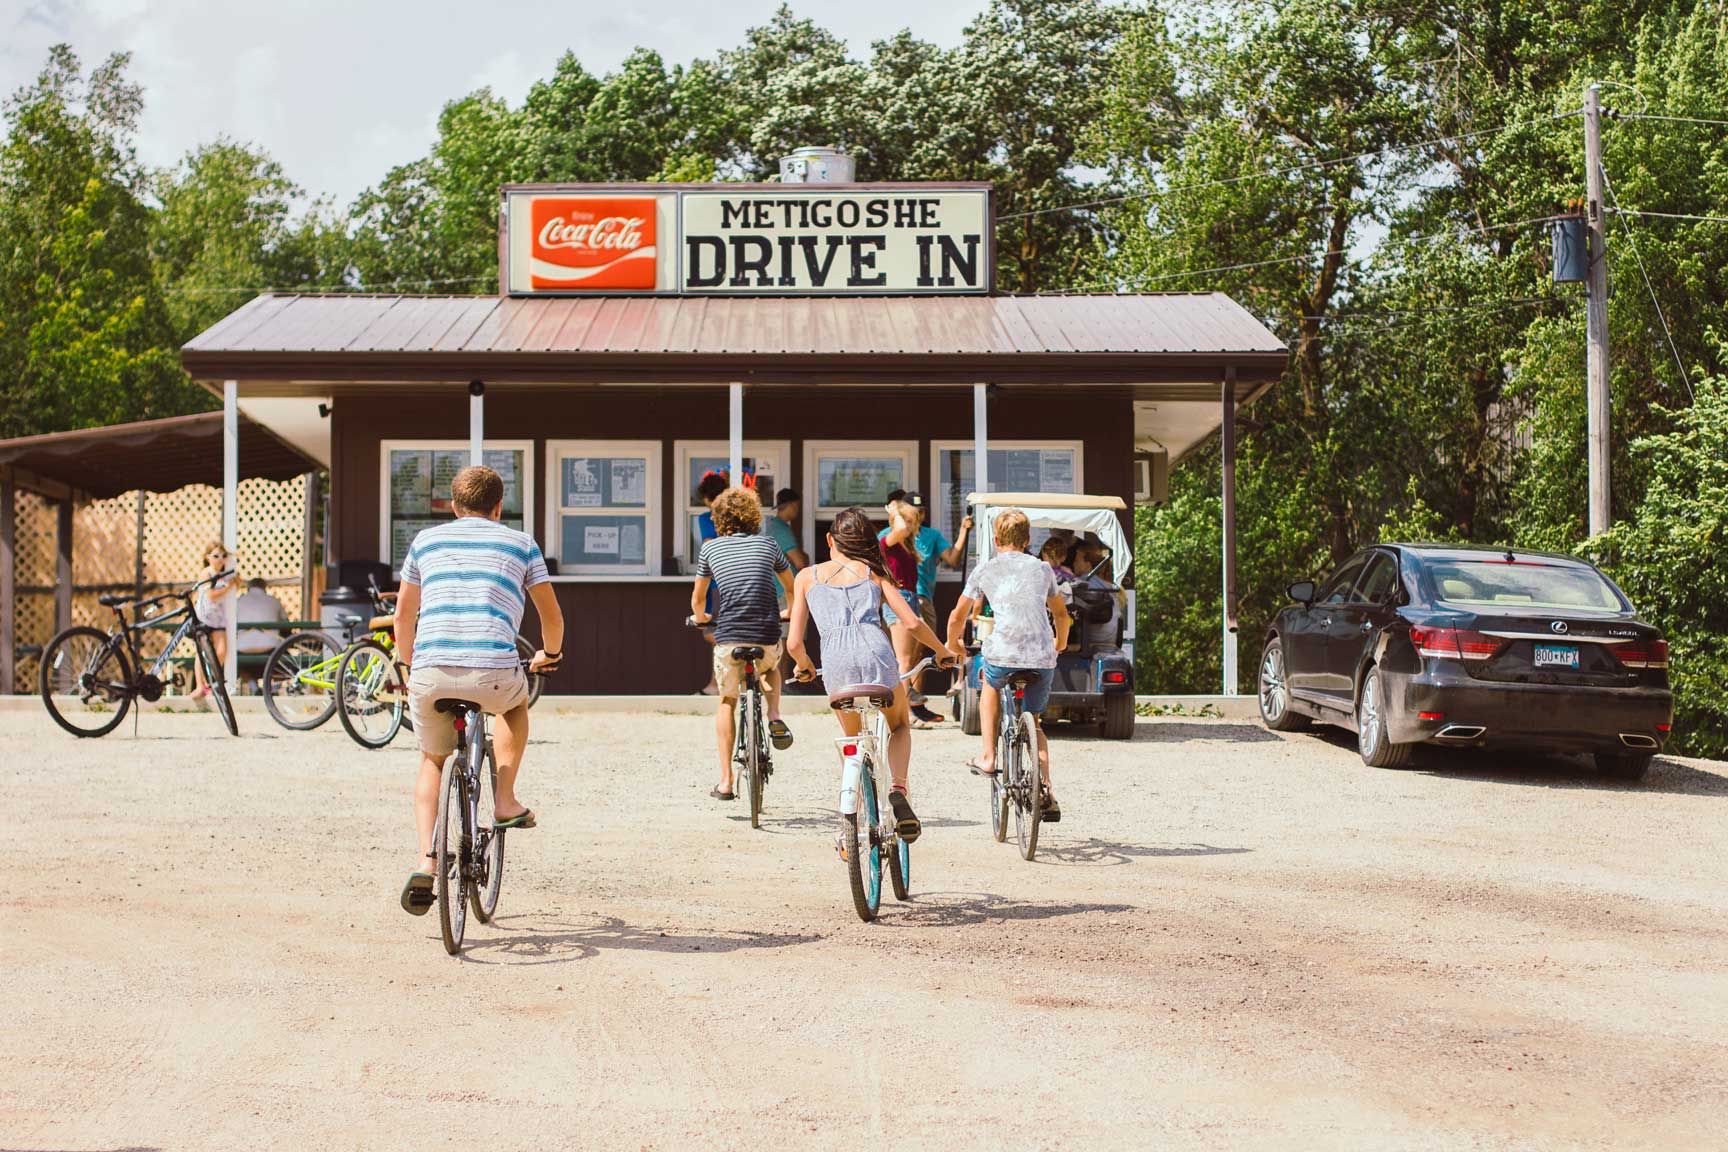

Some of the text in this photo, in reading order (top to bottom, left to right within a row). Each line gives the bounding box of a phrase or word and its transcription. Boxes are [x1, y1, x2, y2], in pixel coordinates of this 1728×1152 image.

[720, 198, 941, 229] METIGOSHE
[538, 216, 646, 250] Coca-Cola
[685, 234, 981, 288] DRIVE IN
